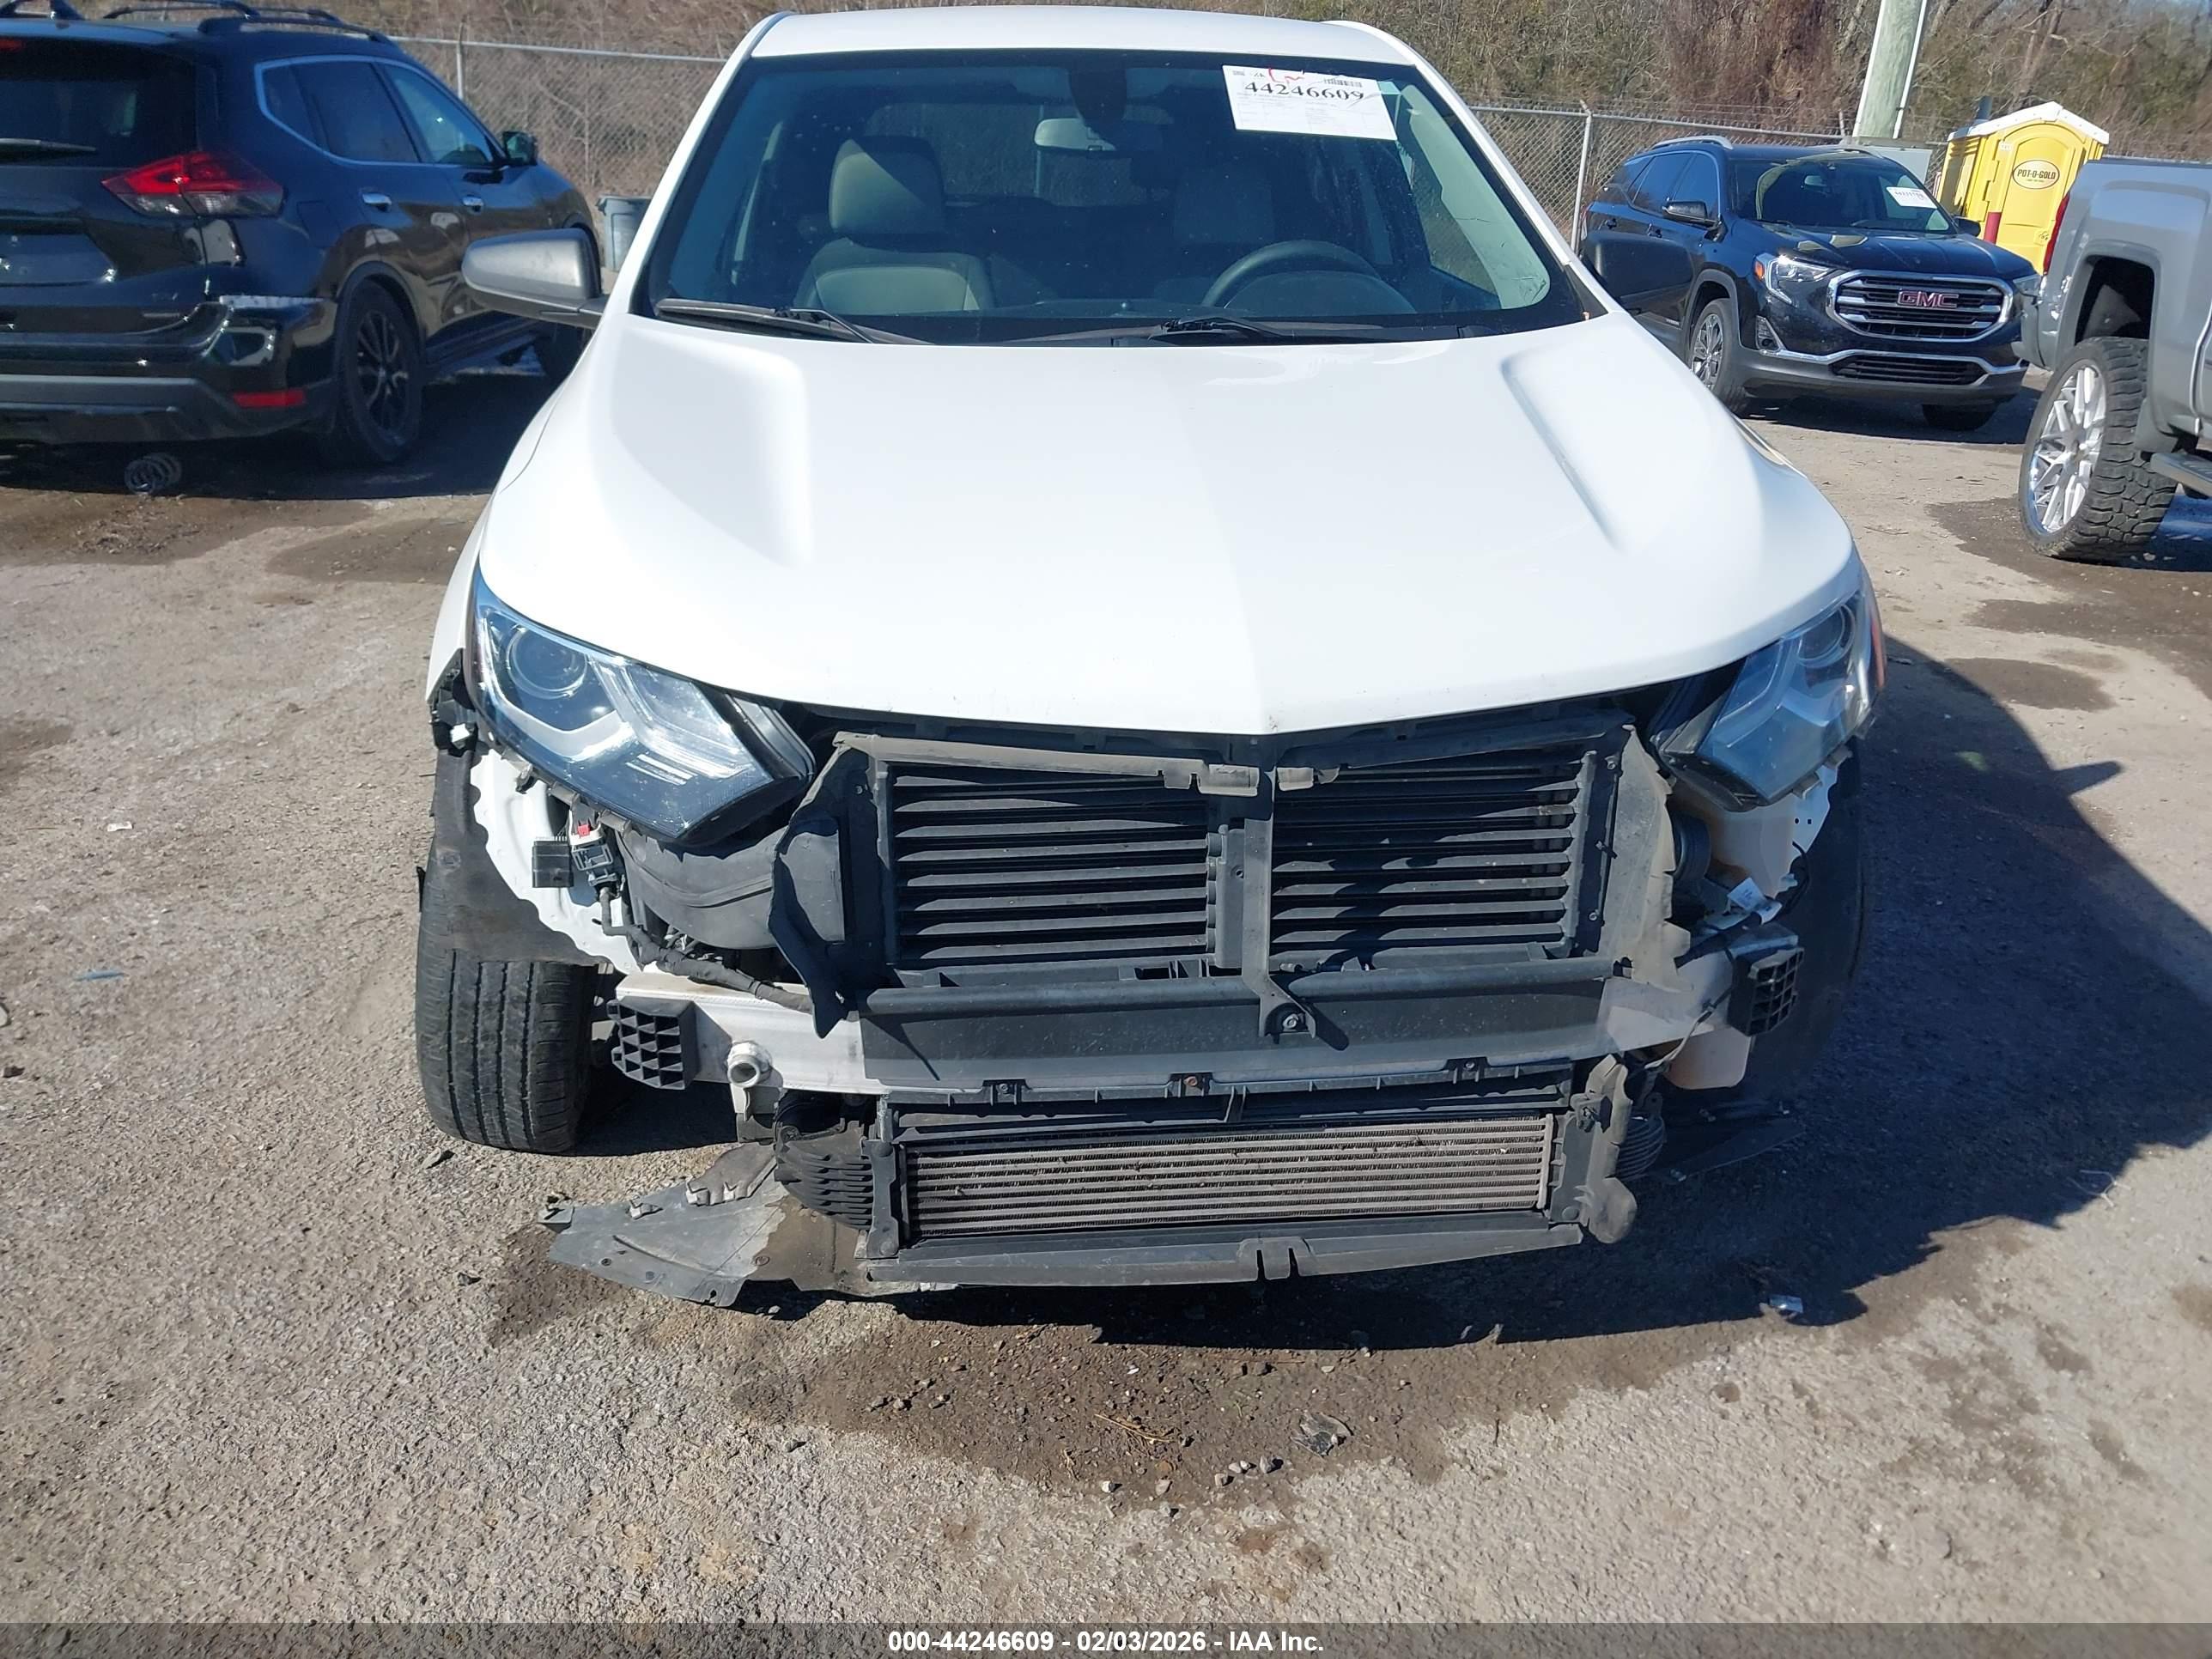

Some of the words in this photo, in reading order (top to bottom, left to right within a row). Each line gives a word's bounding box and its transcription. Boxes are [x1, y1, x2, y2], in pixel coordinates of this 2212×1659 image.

[1244, 82, 1364, 100] 44246609
[2016, 168, 2057, 179] POT-O-GOLD
[1897, 290, 1960, 308] GMC
